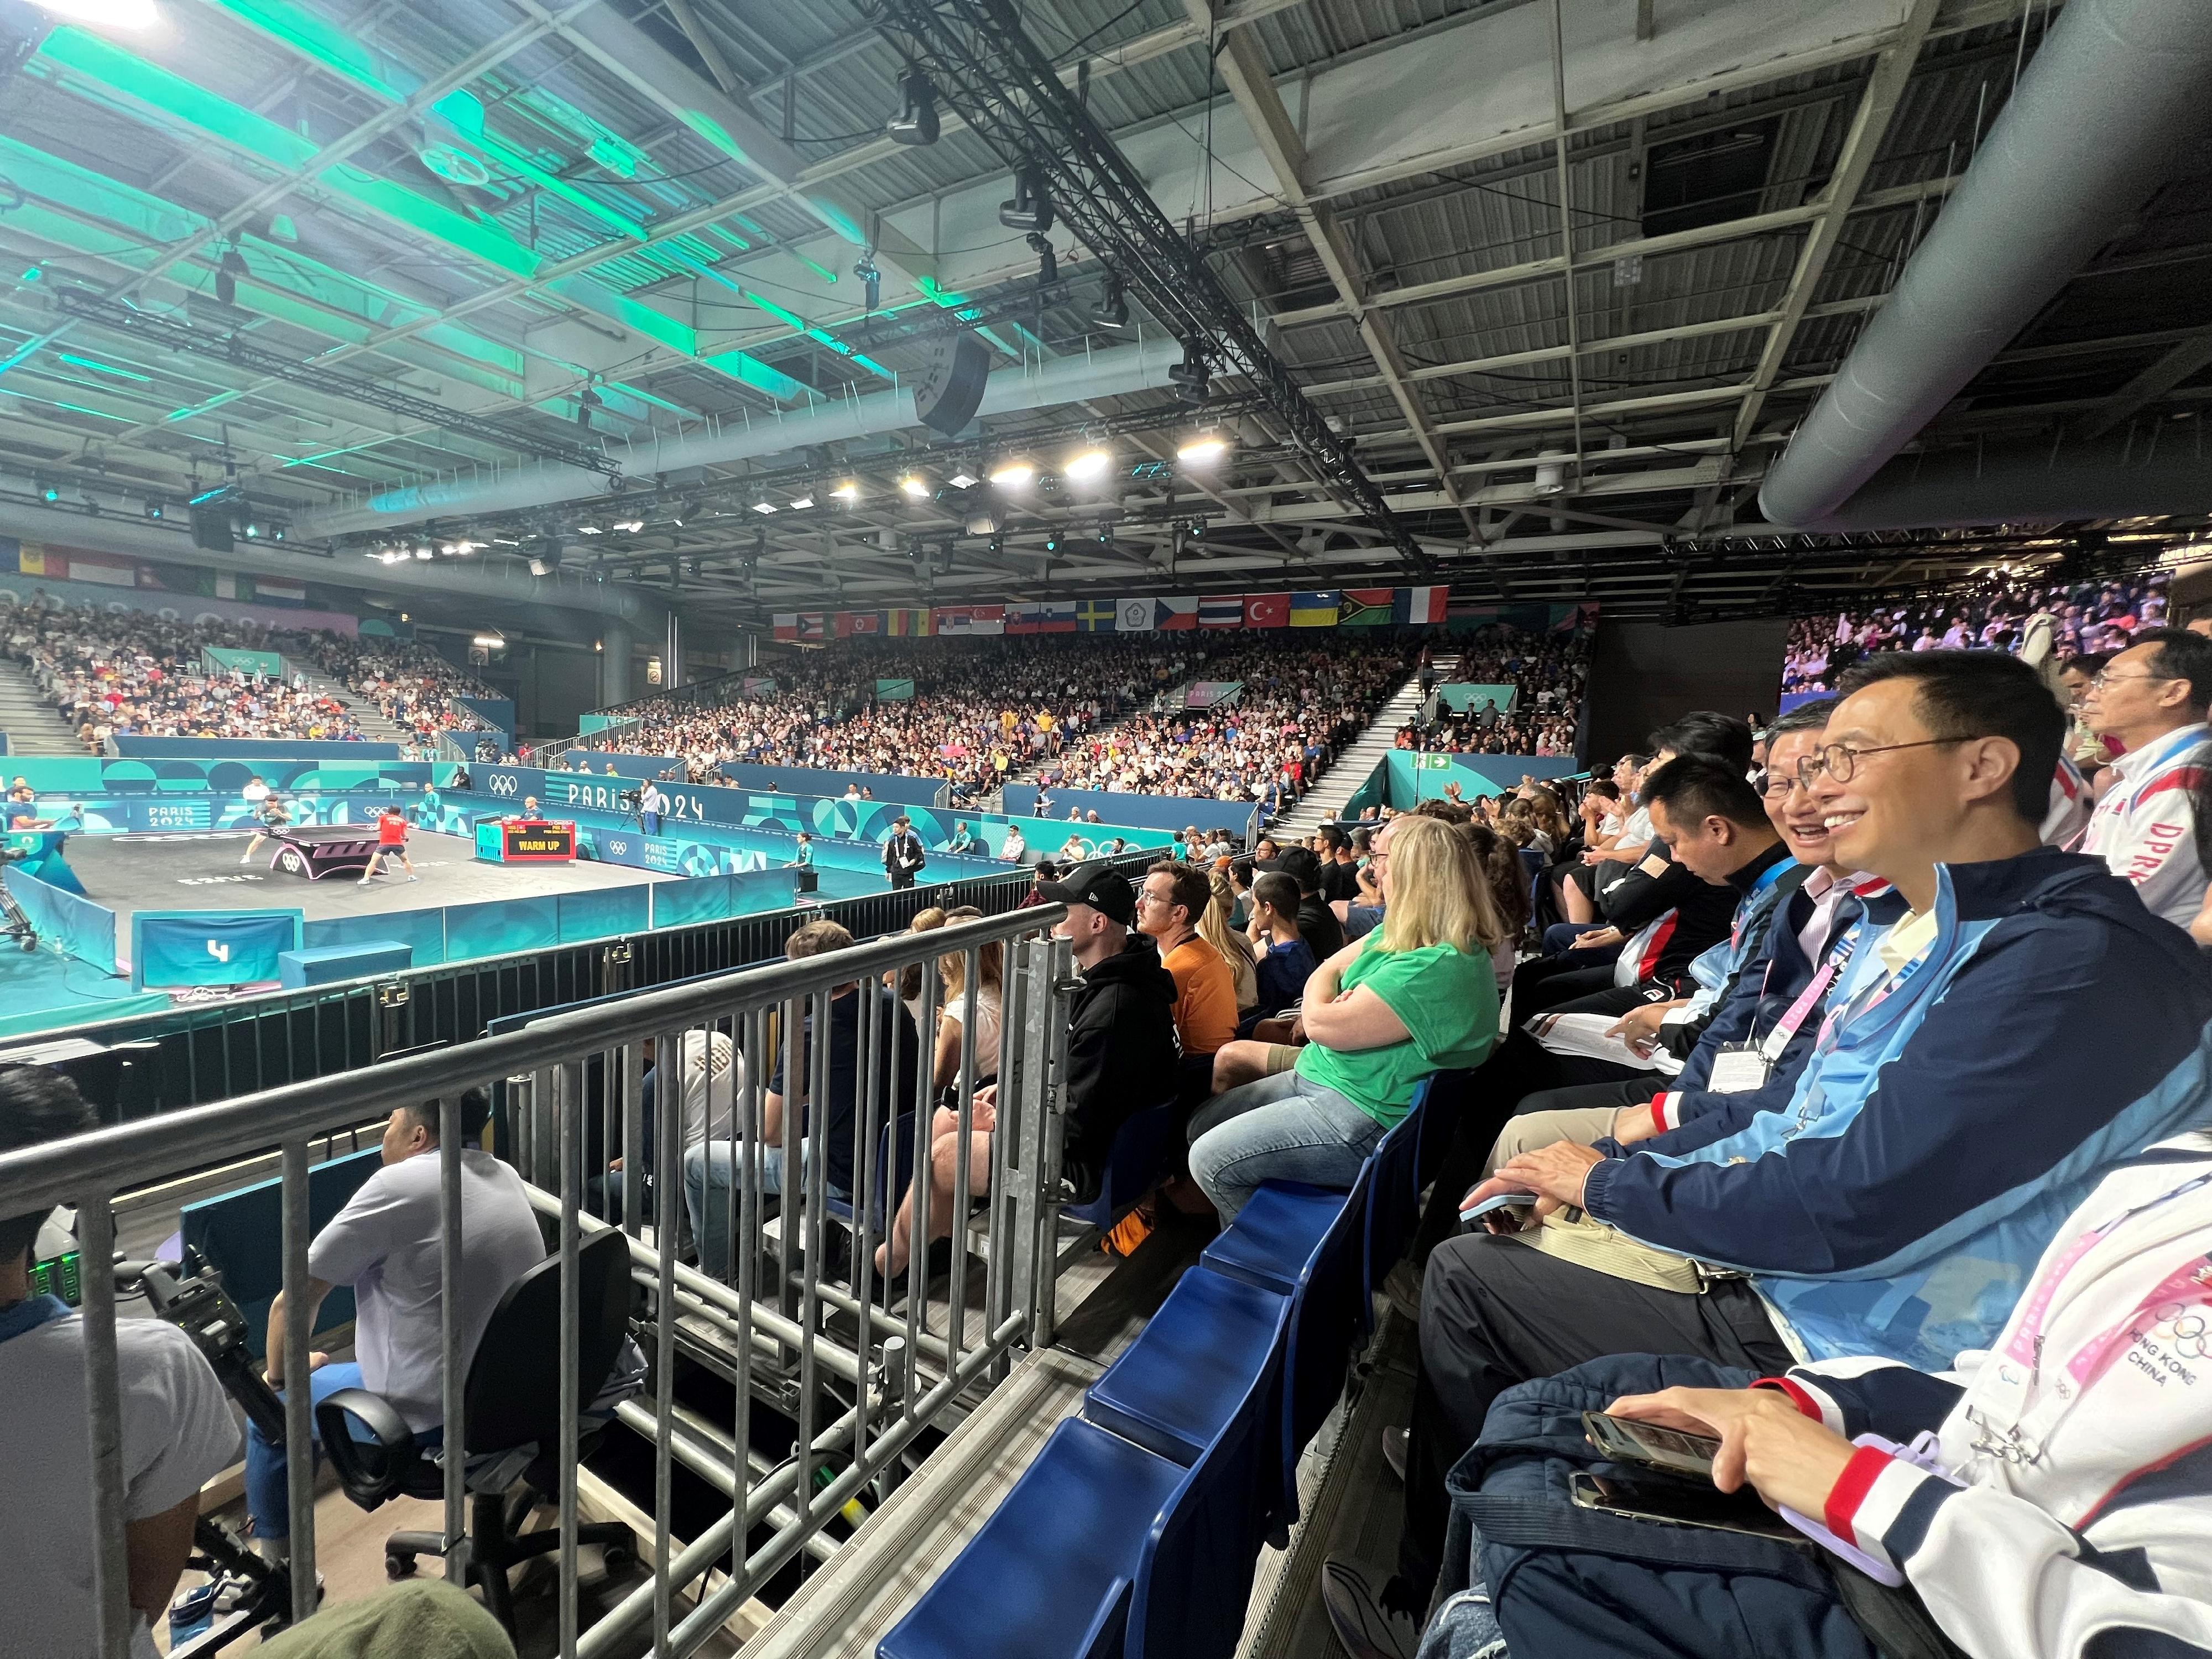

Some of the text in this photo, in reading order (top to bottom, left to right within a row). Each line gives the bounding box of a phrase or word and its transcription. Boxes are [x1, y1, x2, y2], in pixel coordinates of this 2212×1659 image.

[148, 807, 193, 816] PARIS
[149, 817, 194, 827] 2024
[519, 841, 560, 851] WARM UP
[645, 843, 667, 855] PARIS
[2126, 822, 2184, 885] DPRK
[645, 854, 667, 866] 2024
[207, 940, 228, 962] 4
[2127, 1351, 2167, 1387] CHINA
[2158, 1353, 2198, 1386] KONG
